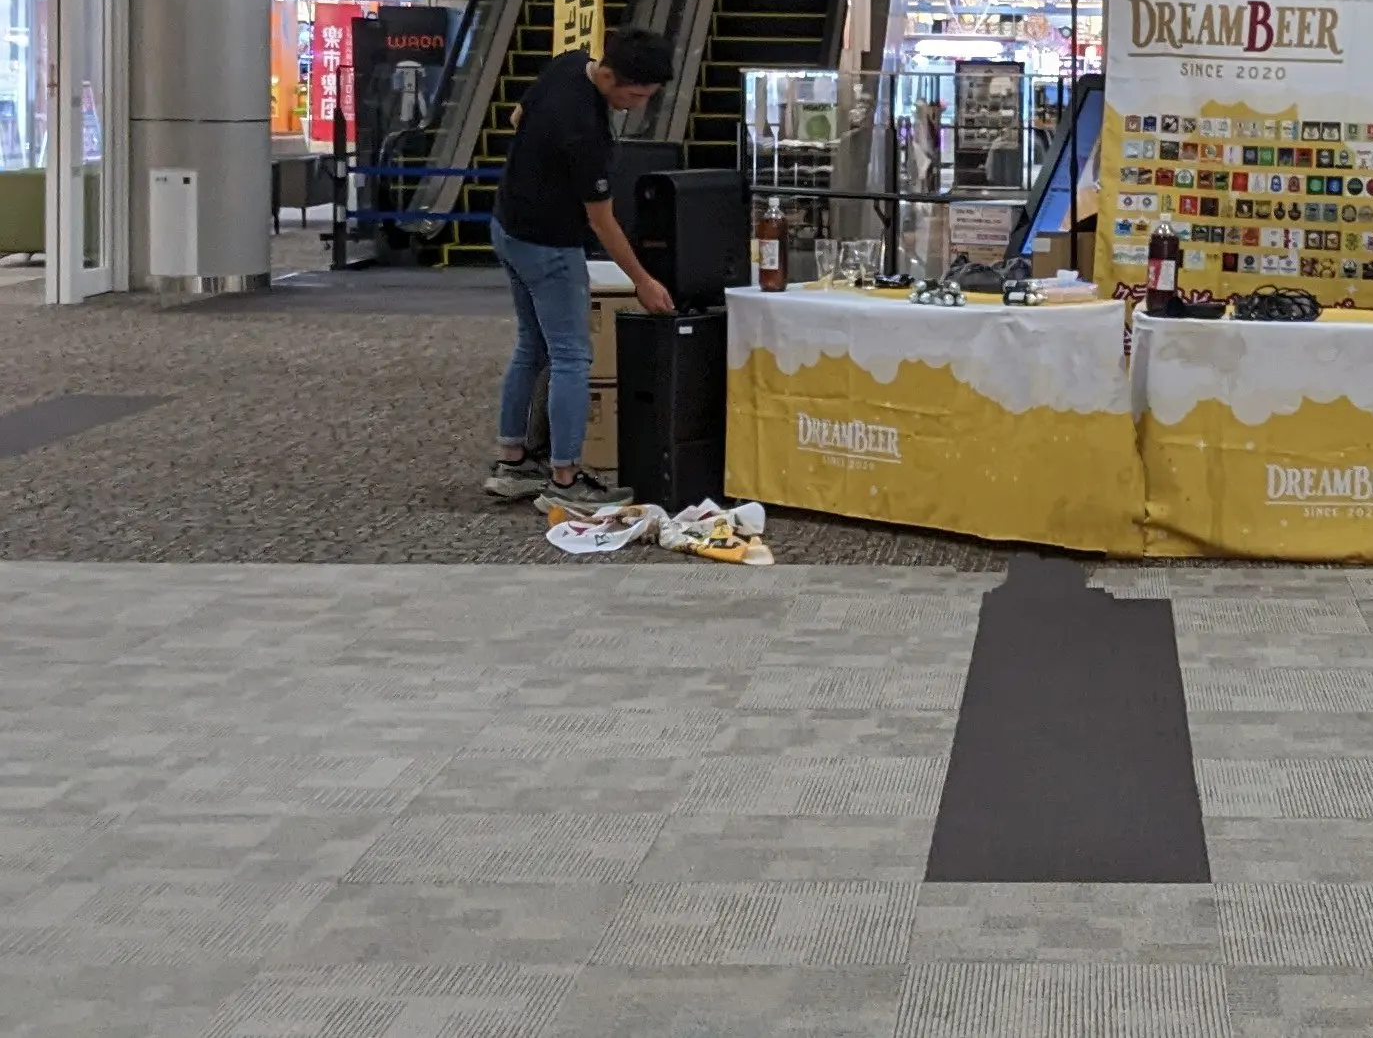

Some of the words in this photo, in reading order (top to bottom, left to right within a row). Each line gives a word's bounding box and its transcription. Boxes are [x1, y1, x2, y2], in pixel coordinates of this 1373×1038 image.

[1179, 62, 1224, 79] SINCE
[1235, 65, 1287, 81] 2020
[796, 412, 902, 458] DREAMBEER
[1302, 506, 1340, 518] SINCE
